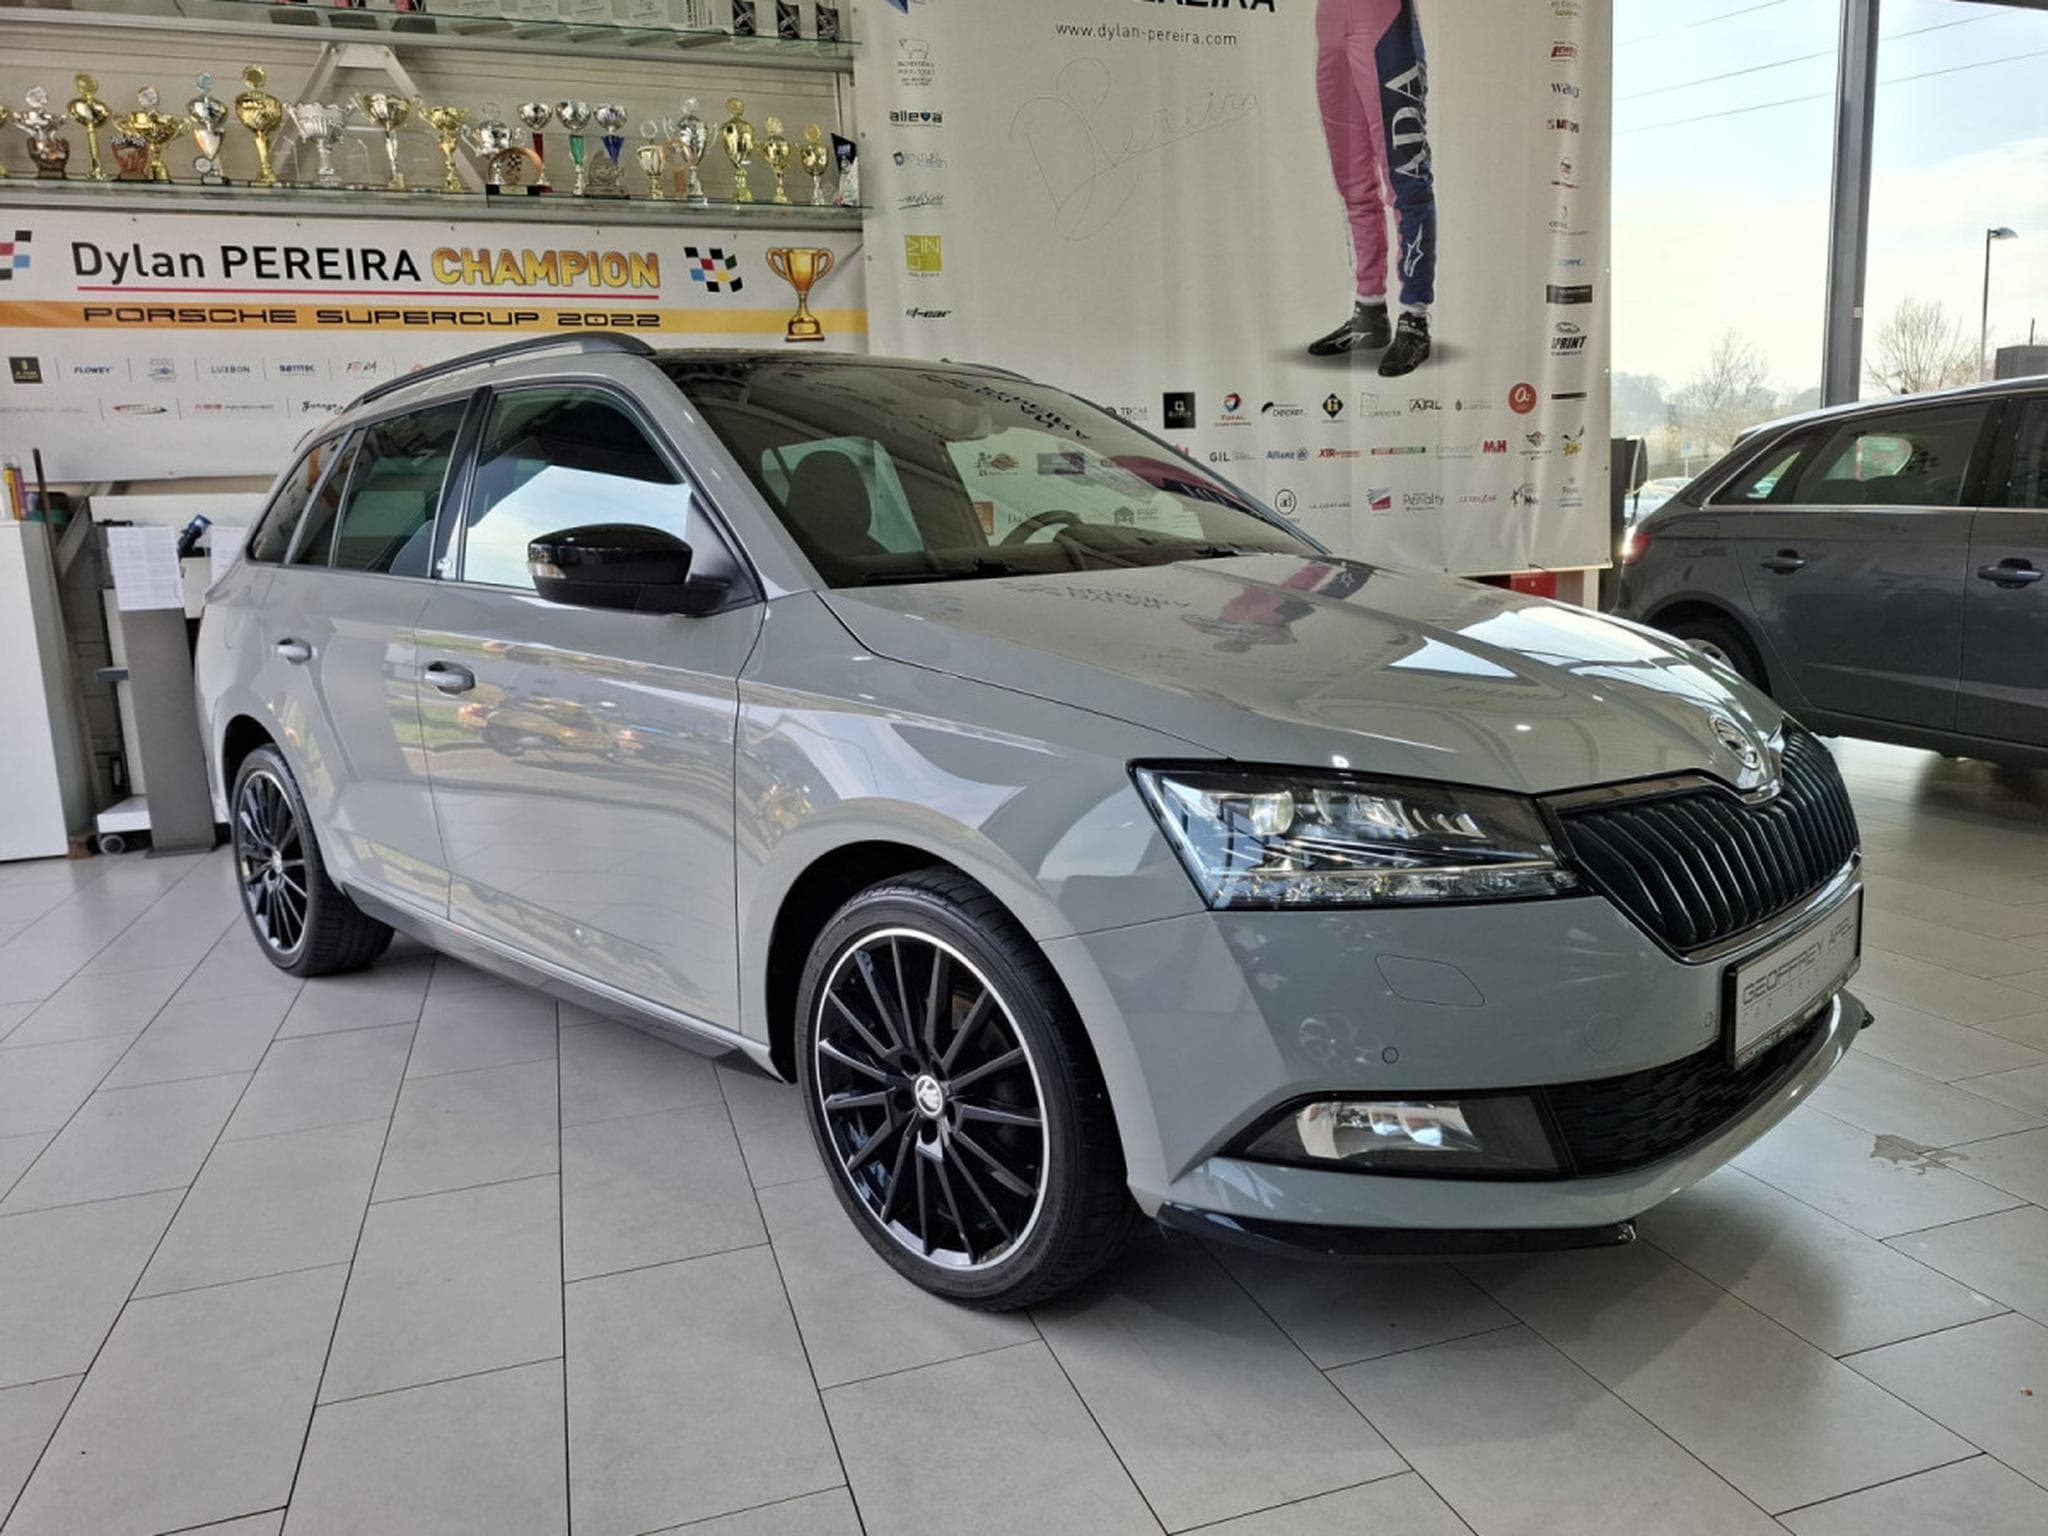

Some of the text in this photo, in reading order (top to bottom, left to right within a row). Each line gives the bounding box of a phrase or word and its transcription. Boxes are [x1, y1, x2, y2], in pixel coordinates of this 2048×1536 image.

[1055, 23, 1237, 46] www.dylan-pereira.com
[71, 241, 661, 289] Dylan PEREIRA CHAMPION
[83, 306, 661, 328] PORSCHE SUPERCUP 2022
